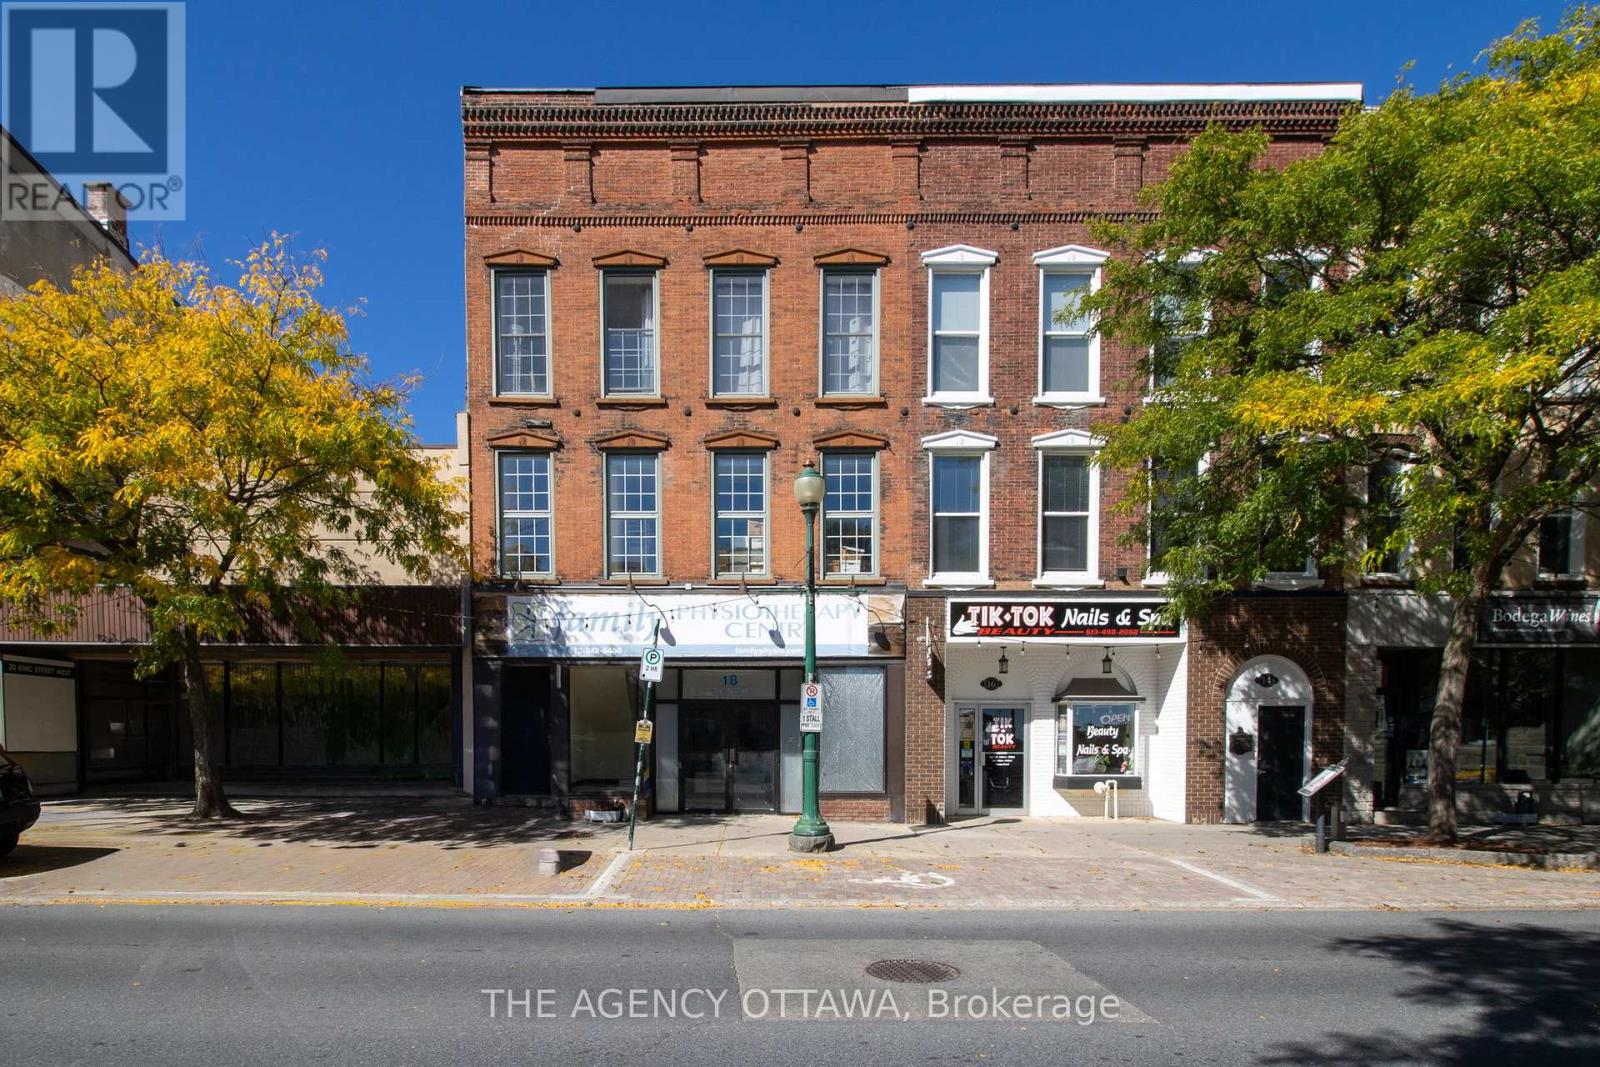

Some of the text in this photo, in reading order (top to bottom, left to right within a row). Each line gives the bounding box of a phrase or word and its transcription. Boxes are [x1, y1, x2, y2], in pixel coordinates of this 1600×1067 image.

[676, 603, 859, 620] PHYSIOTHEAPY
[1061, 608, 1109, 628] Nails
[1115, 608, 1132, 627] &
[724, 622, 803, 638] CENTR
[977, 627, 1056, 636] BEAUTY
[722, 675, 737, 686] 18
[1100, 713, 1131, 725] OPEN
[991, 733, 1015, 745] TOK
[1086, 725, 1119, 739] Beauty
[1076, 743, 1129, 758] Nails & Spa
